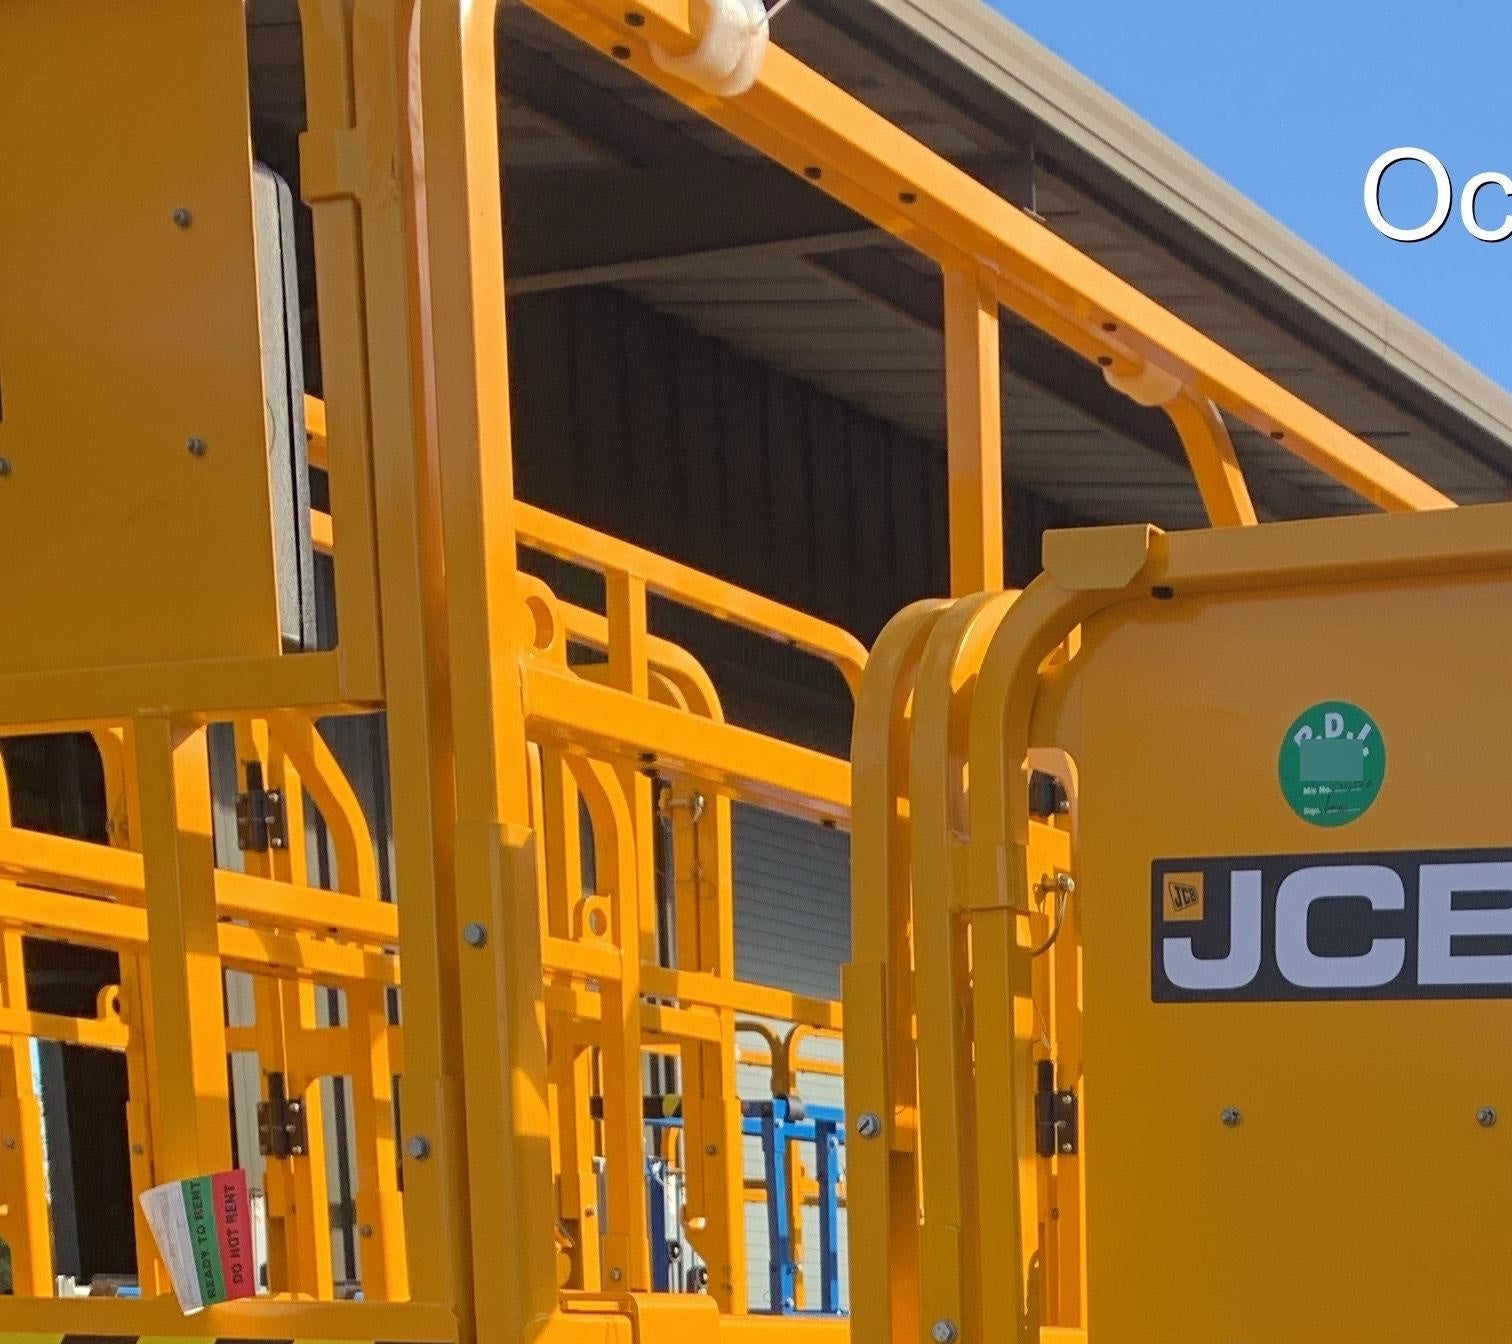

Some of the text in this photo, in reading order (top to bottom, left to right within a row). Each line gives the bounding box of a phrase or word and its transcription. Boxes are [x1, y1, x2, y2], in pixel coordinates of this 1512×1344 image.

[1174, 885, 1198, 909] JCB
[190, 1181, 217, 1298] READY TO RENT
[224, 1184, 244, 1284] DO NOT RENT
